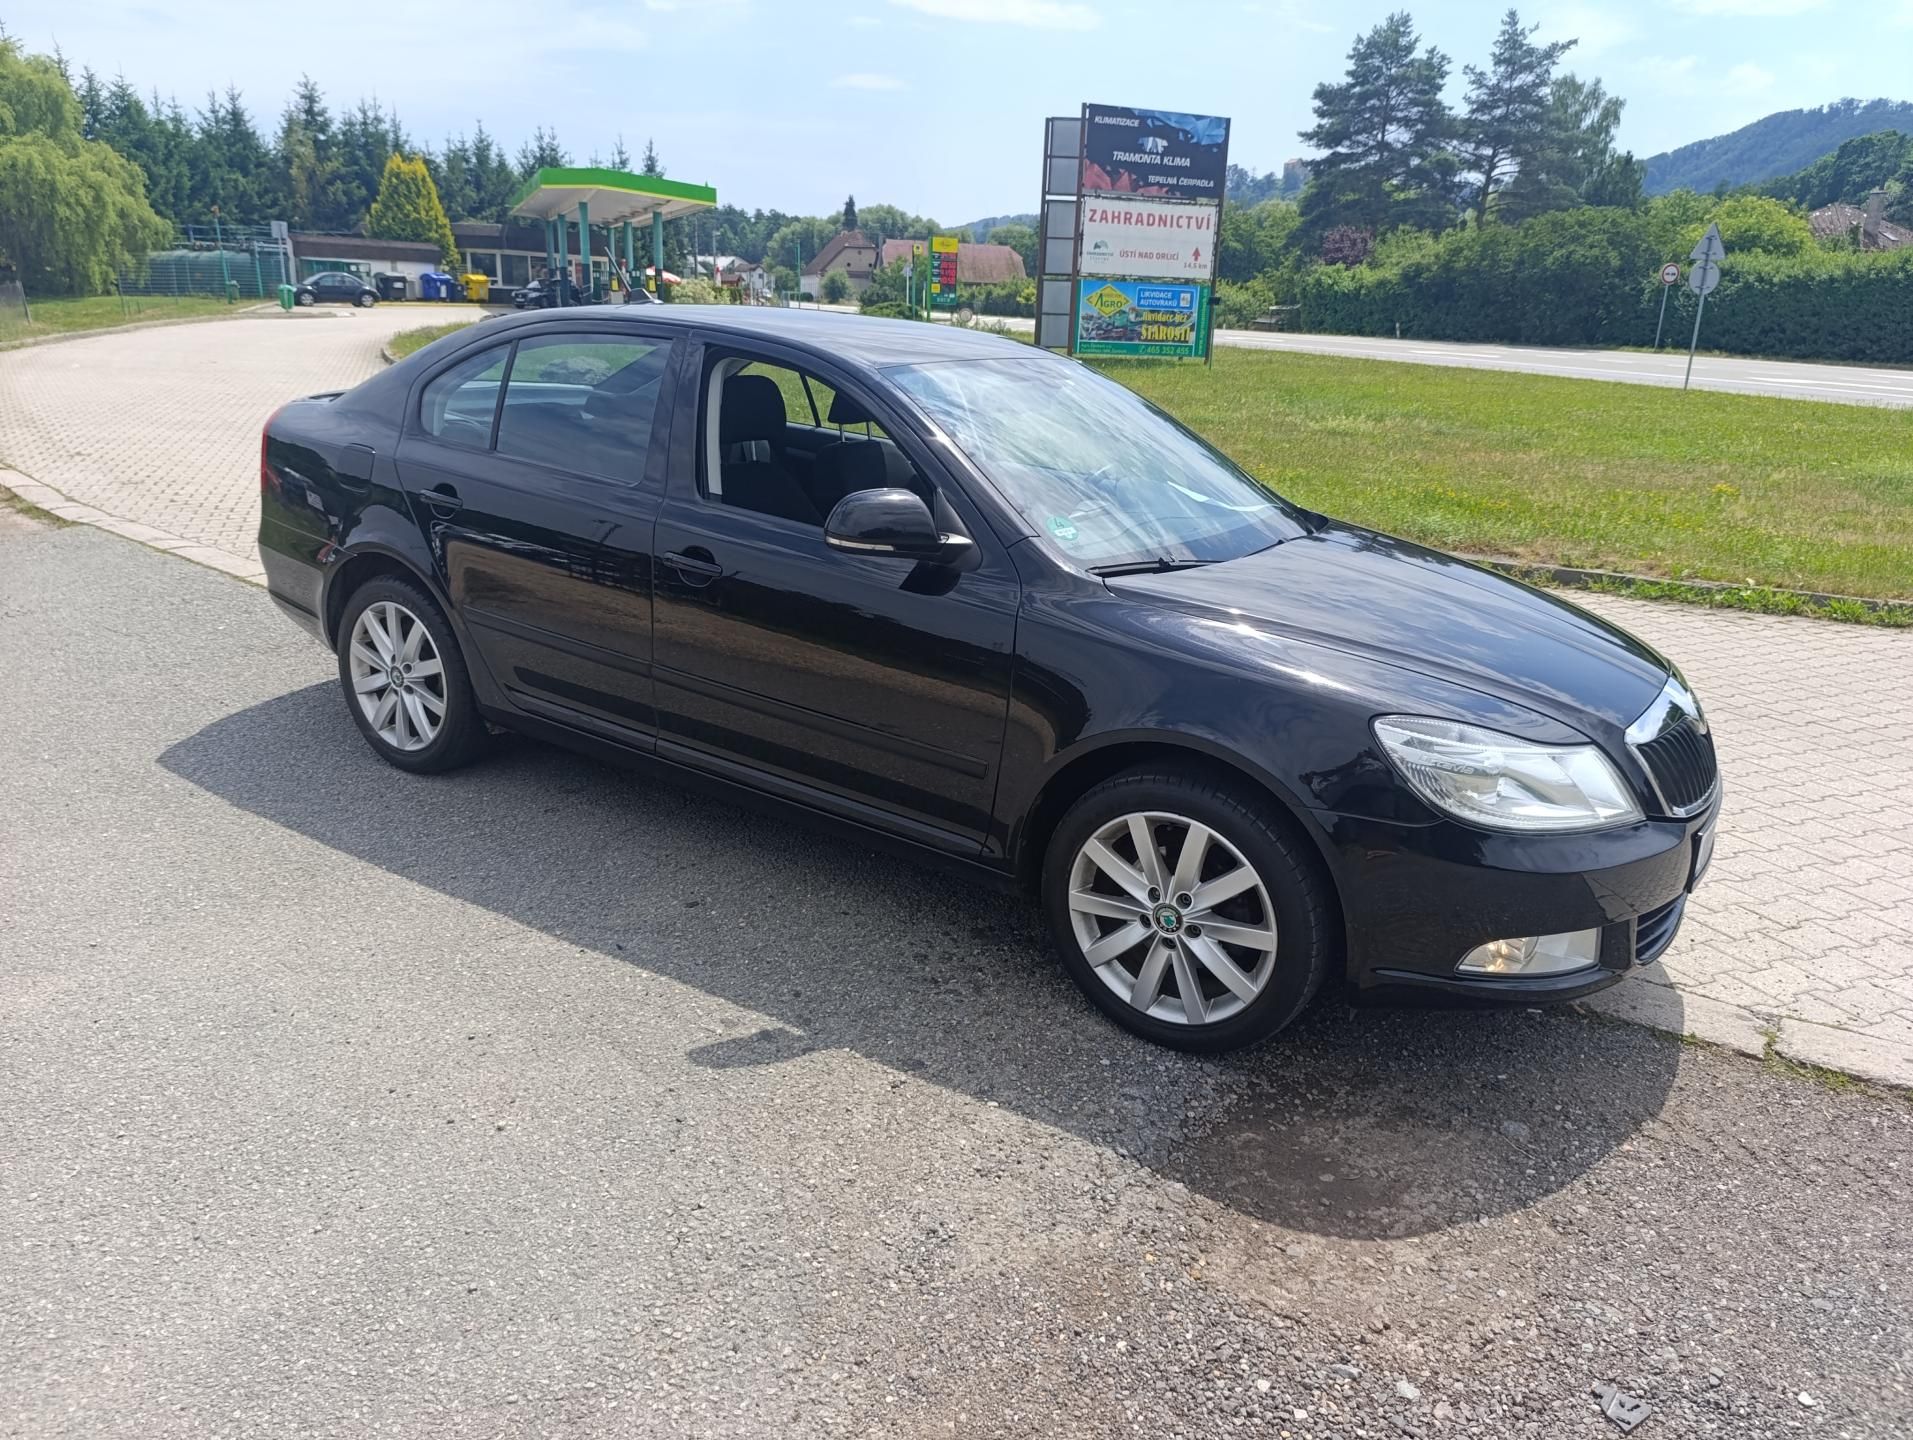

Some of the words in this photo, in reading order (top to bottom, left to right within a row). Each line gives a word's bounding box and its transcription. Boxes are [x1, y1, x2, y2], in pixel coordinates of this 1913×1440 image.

[1094, 115, 1140, 127] KLIMATIZACE
[1112, 151, 1161, 165] TRAMONTA
[1163, 156, 1191, 167] KLIMA
[1148, 175, 1177, 185] TEPELNÁ
[1178, 178, 1214, 188] ČERPADLA
[1088, 208, 1211, 230] ZAHRADNICTVÍ
[1119, 249, 1136, 259] ÚSTÍ
[1138, 252, 1154, 260] NAD
[1155, 252, 1179, 261] ORLICÍ
[1147, 346, 1160, 354] 465
